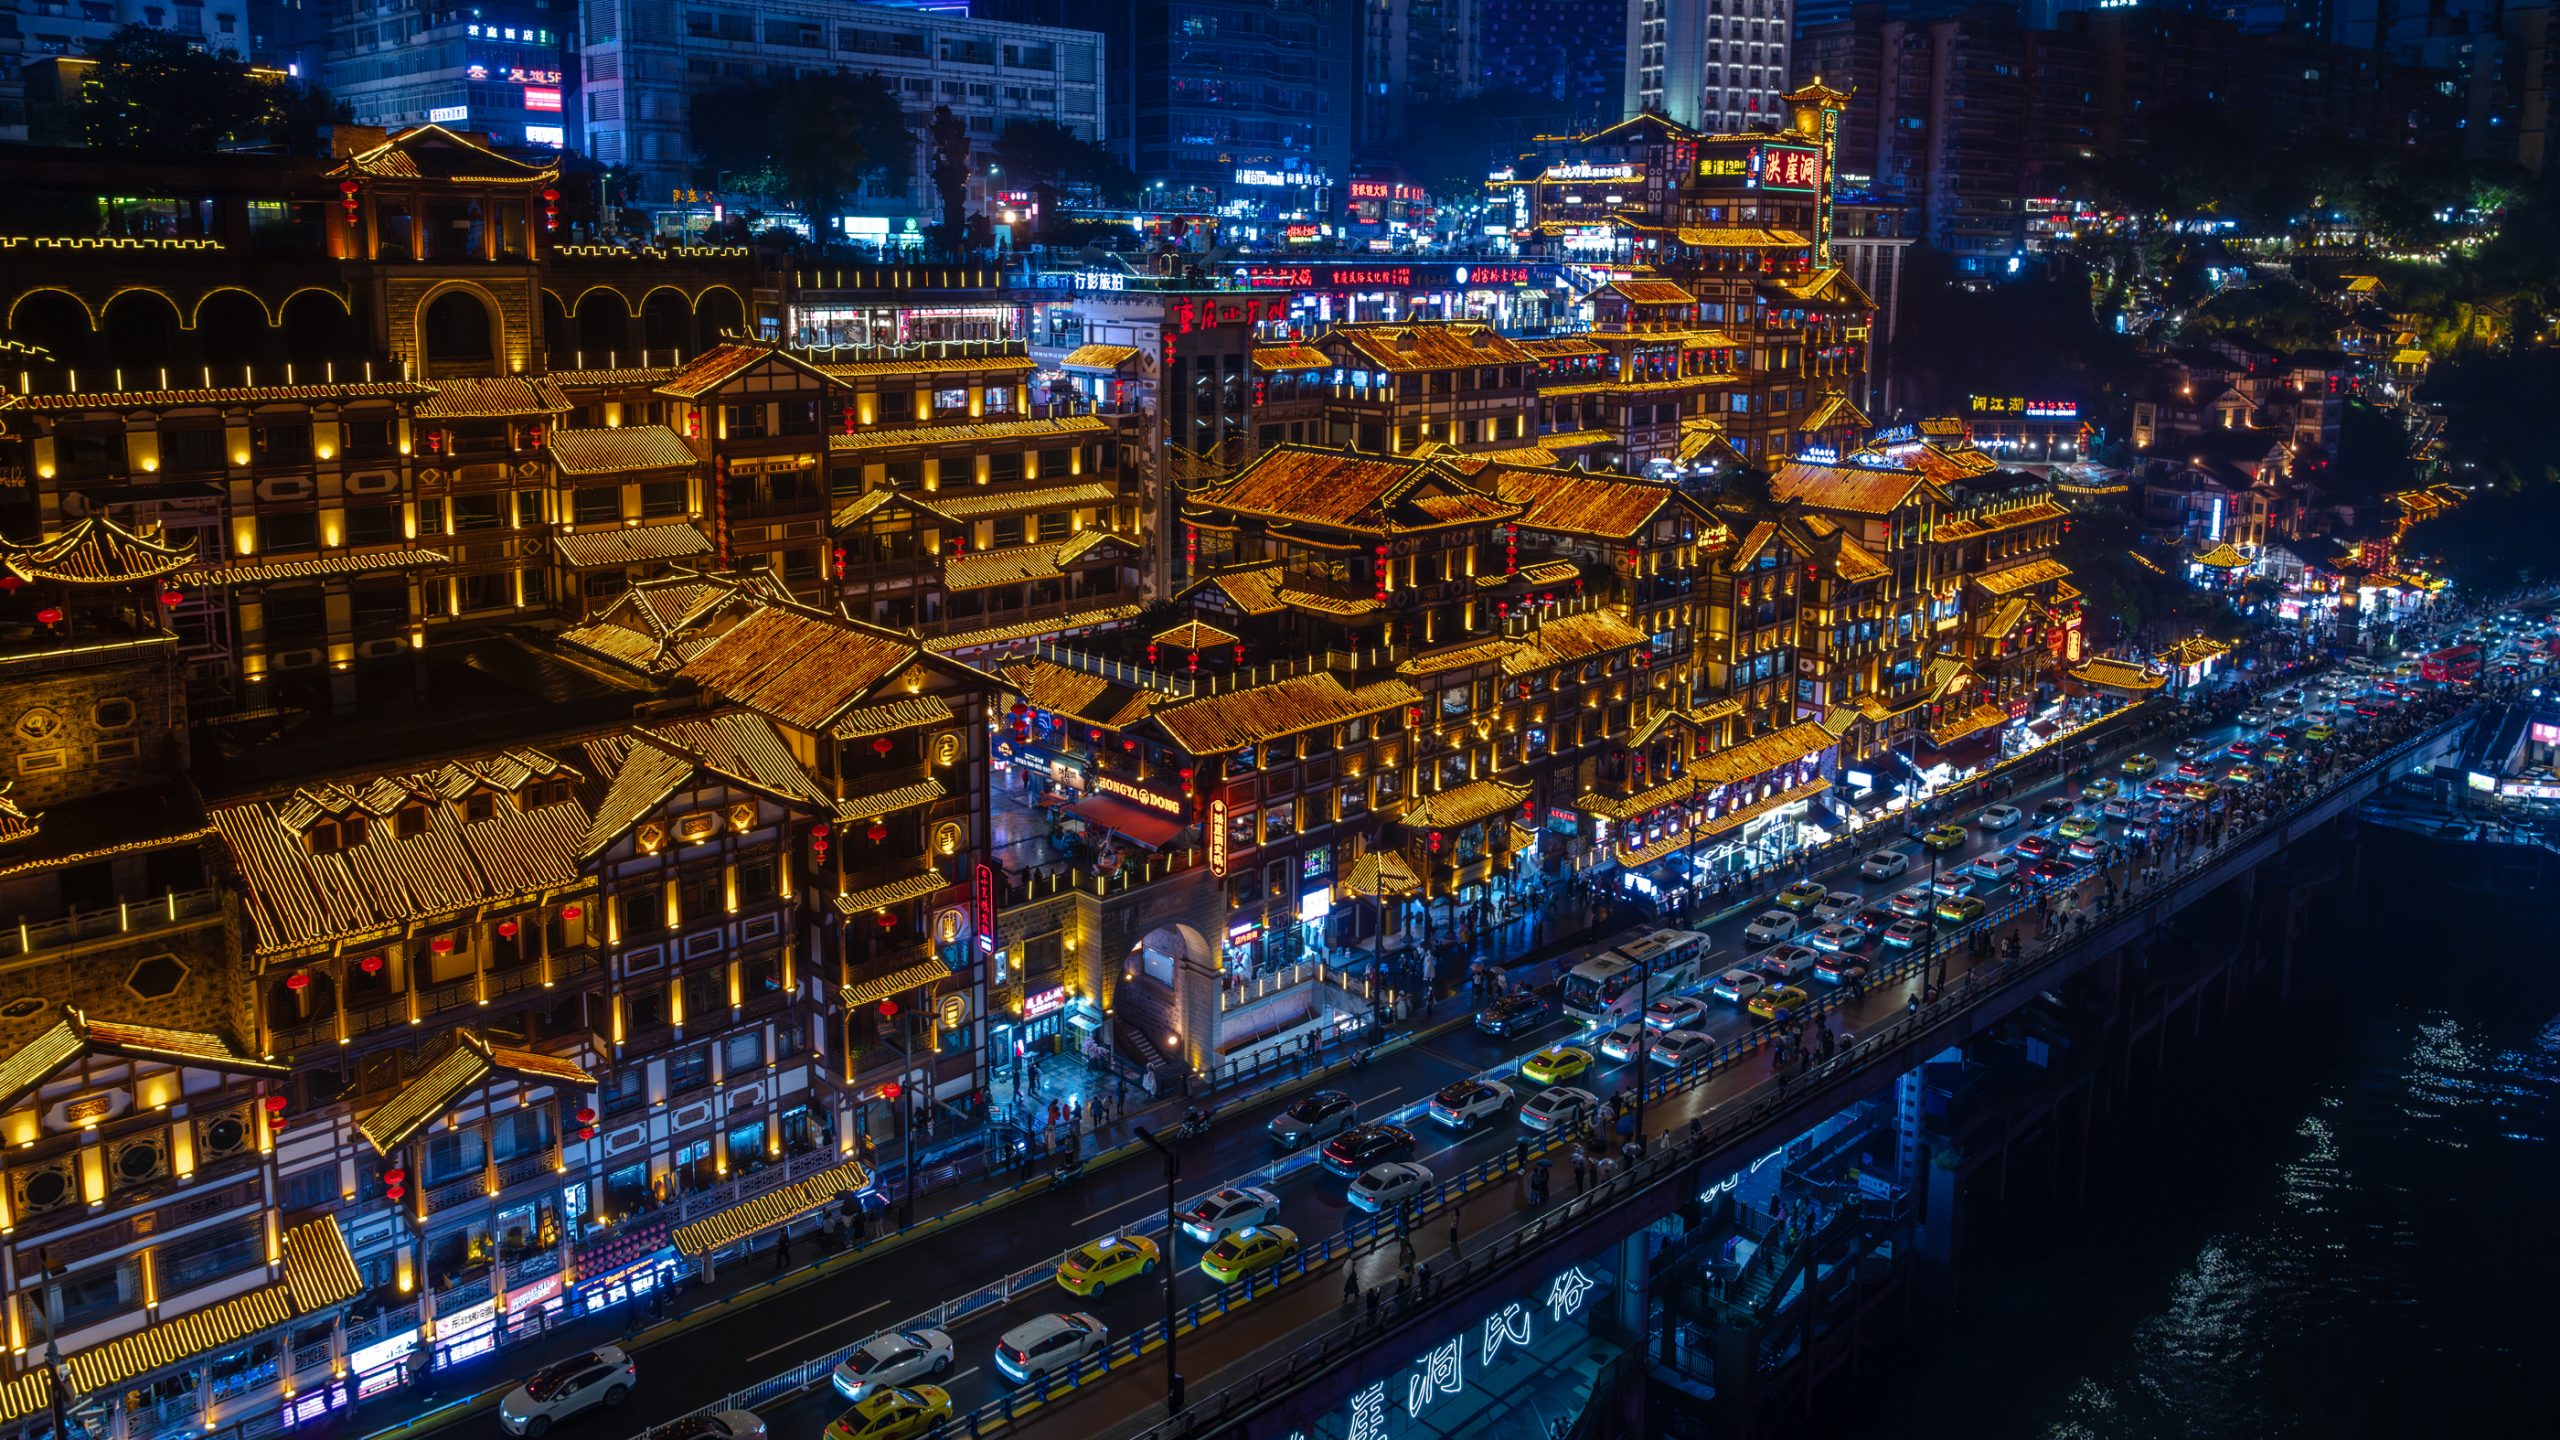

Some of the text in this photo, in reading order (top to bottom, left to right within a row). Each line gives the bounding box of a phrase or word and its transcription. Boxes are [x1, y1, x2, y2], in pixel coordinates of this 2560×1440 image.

[1766, 152, 1814, 184] 洪崖洞
[1074, 272, 1124, 290] 行影旅拍
[1471, 267, 1528, 283] 九宫格老火锅
[1099, 776, 1180, 814] HONGYA DONG
